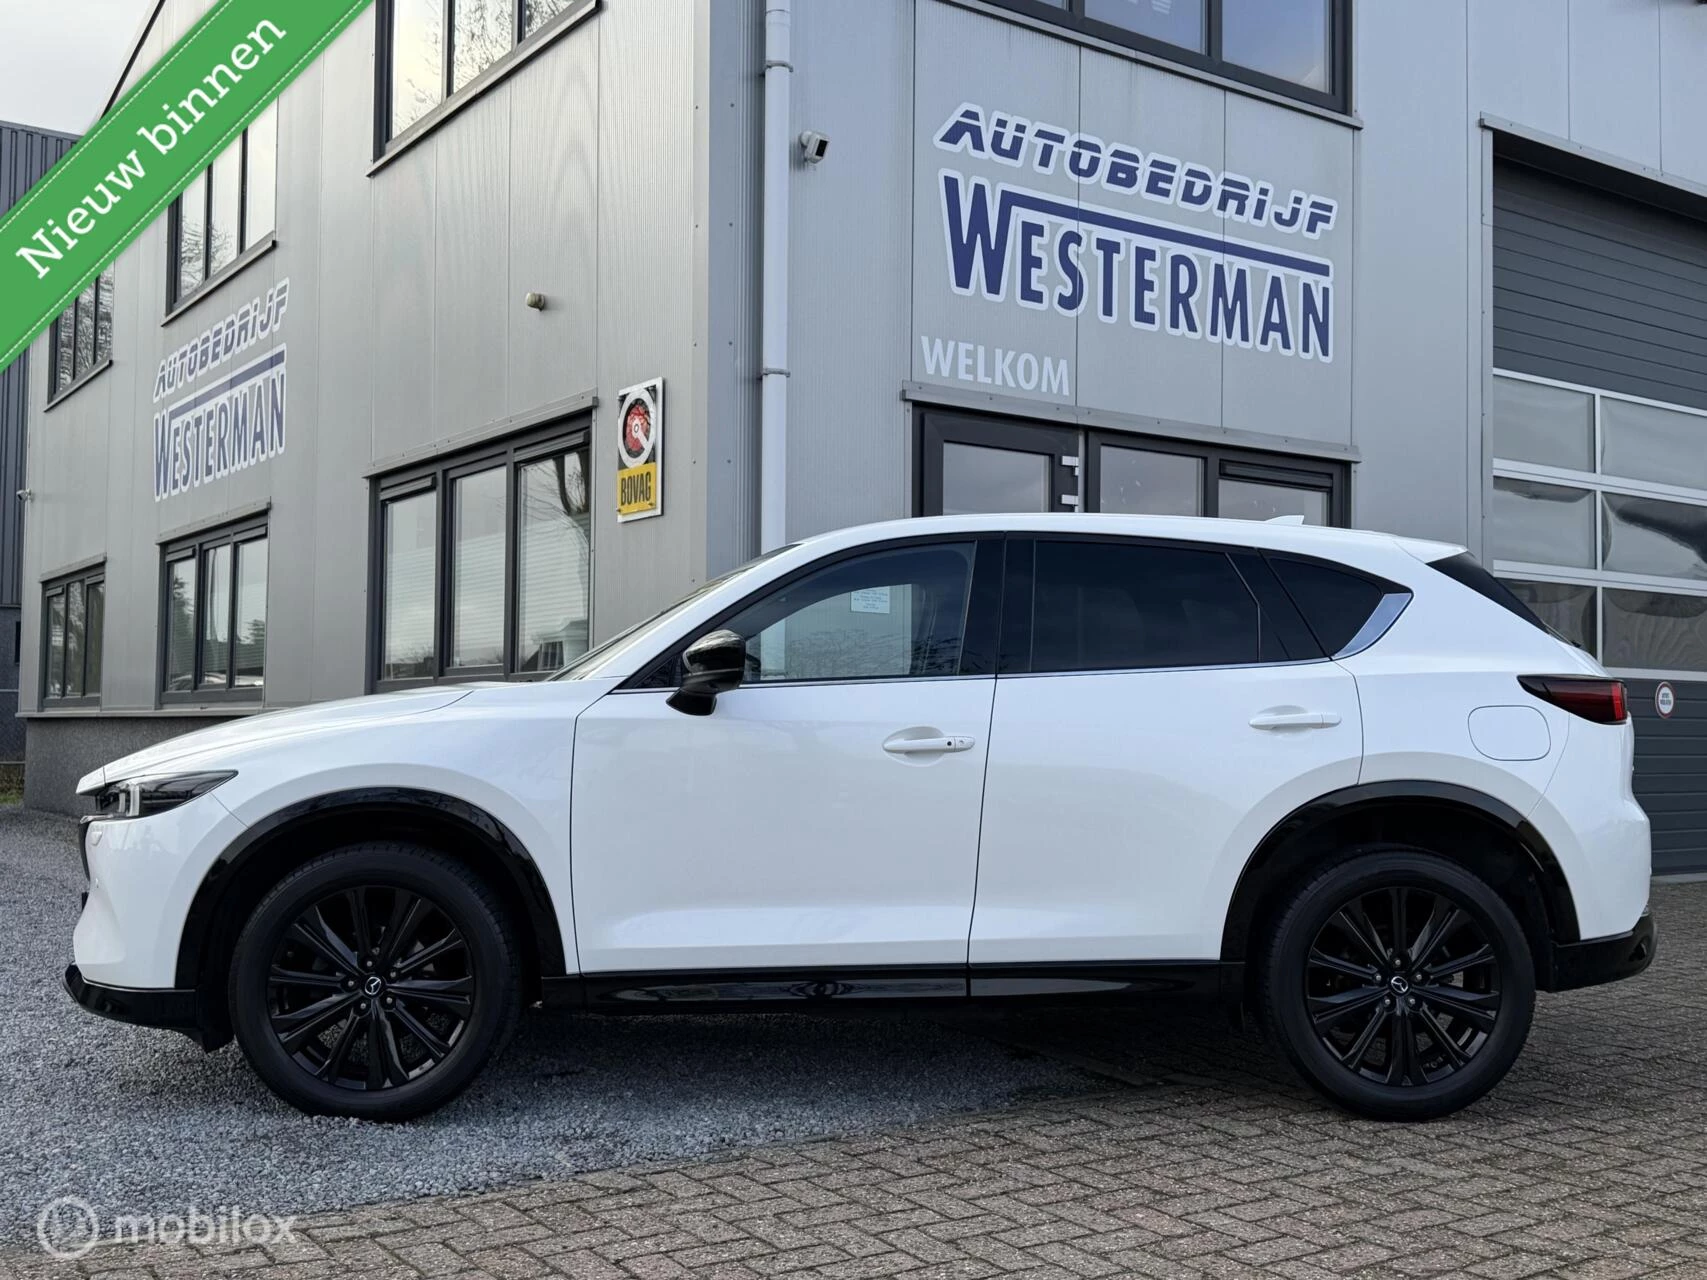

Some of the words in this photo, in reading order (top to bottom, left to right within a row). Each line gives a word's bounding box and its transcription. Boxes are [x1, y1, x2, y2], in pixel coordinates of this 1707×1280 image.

[940, 170, 1333, 361] WESTERMAN
[921, 336, 1070, 396] WELKOM
[154, 355, 286, 501] WESTERMAN
[620, 471, 652, 506] BOVAG
